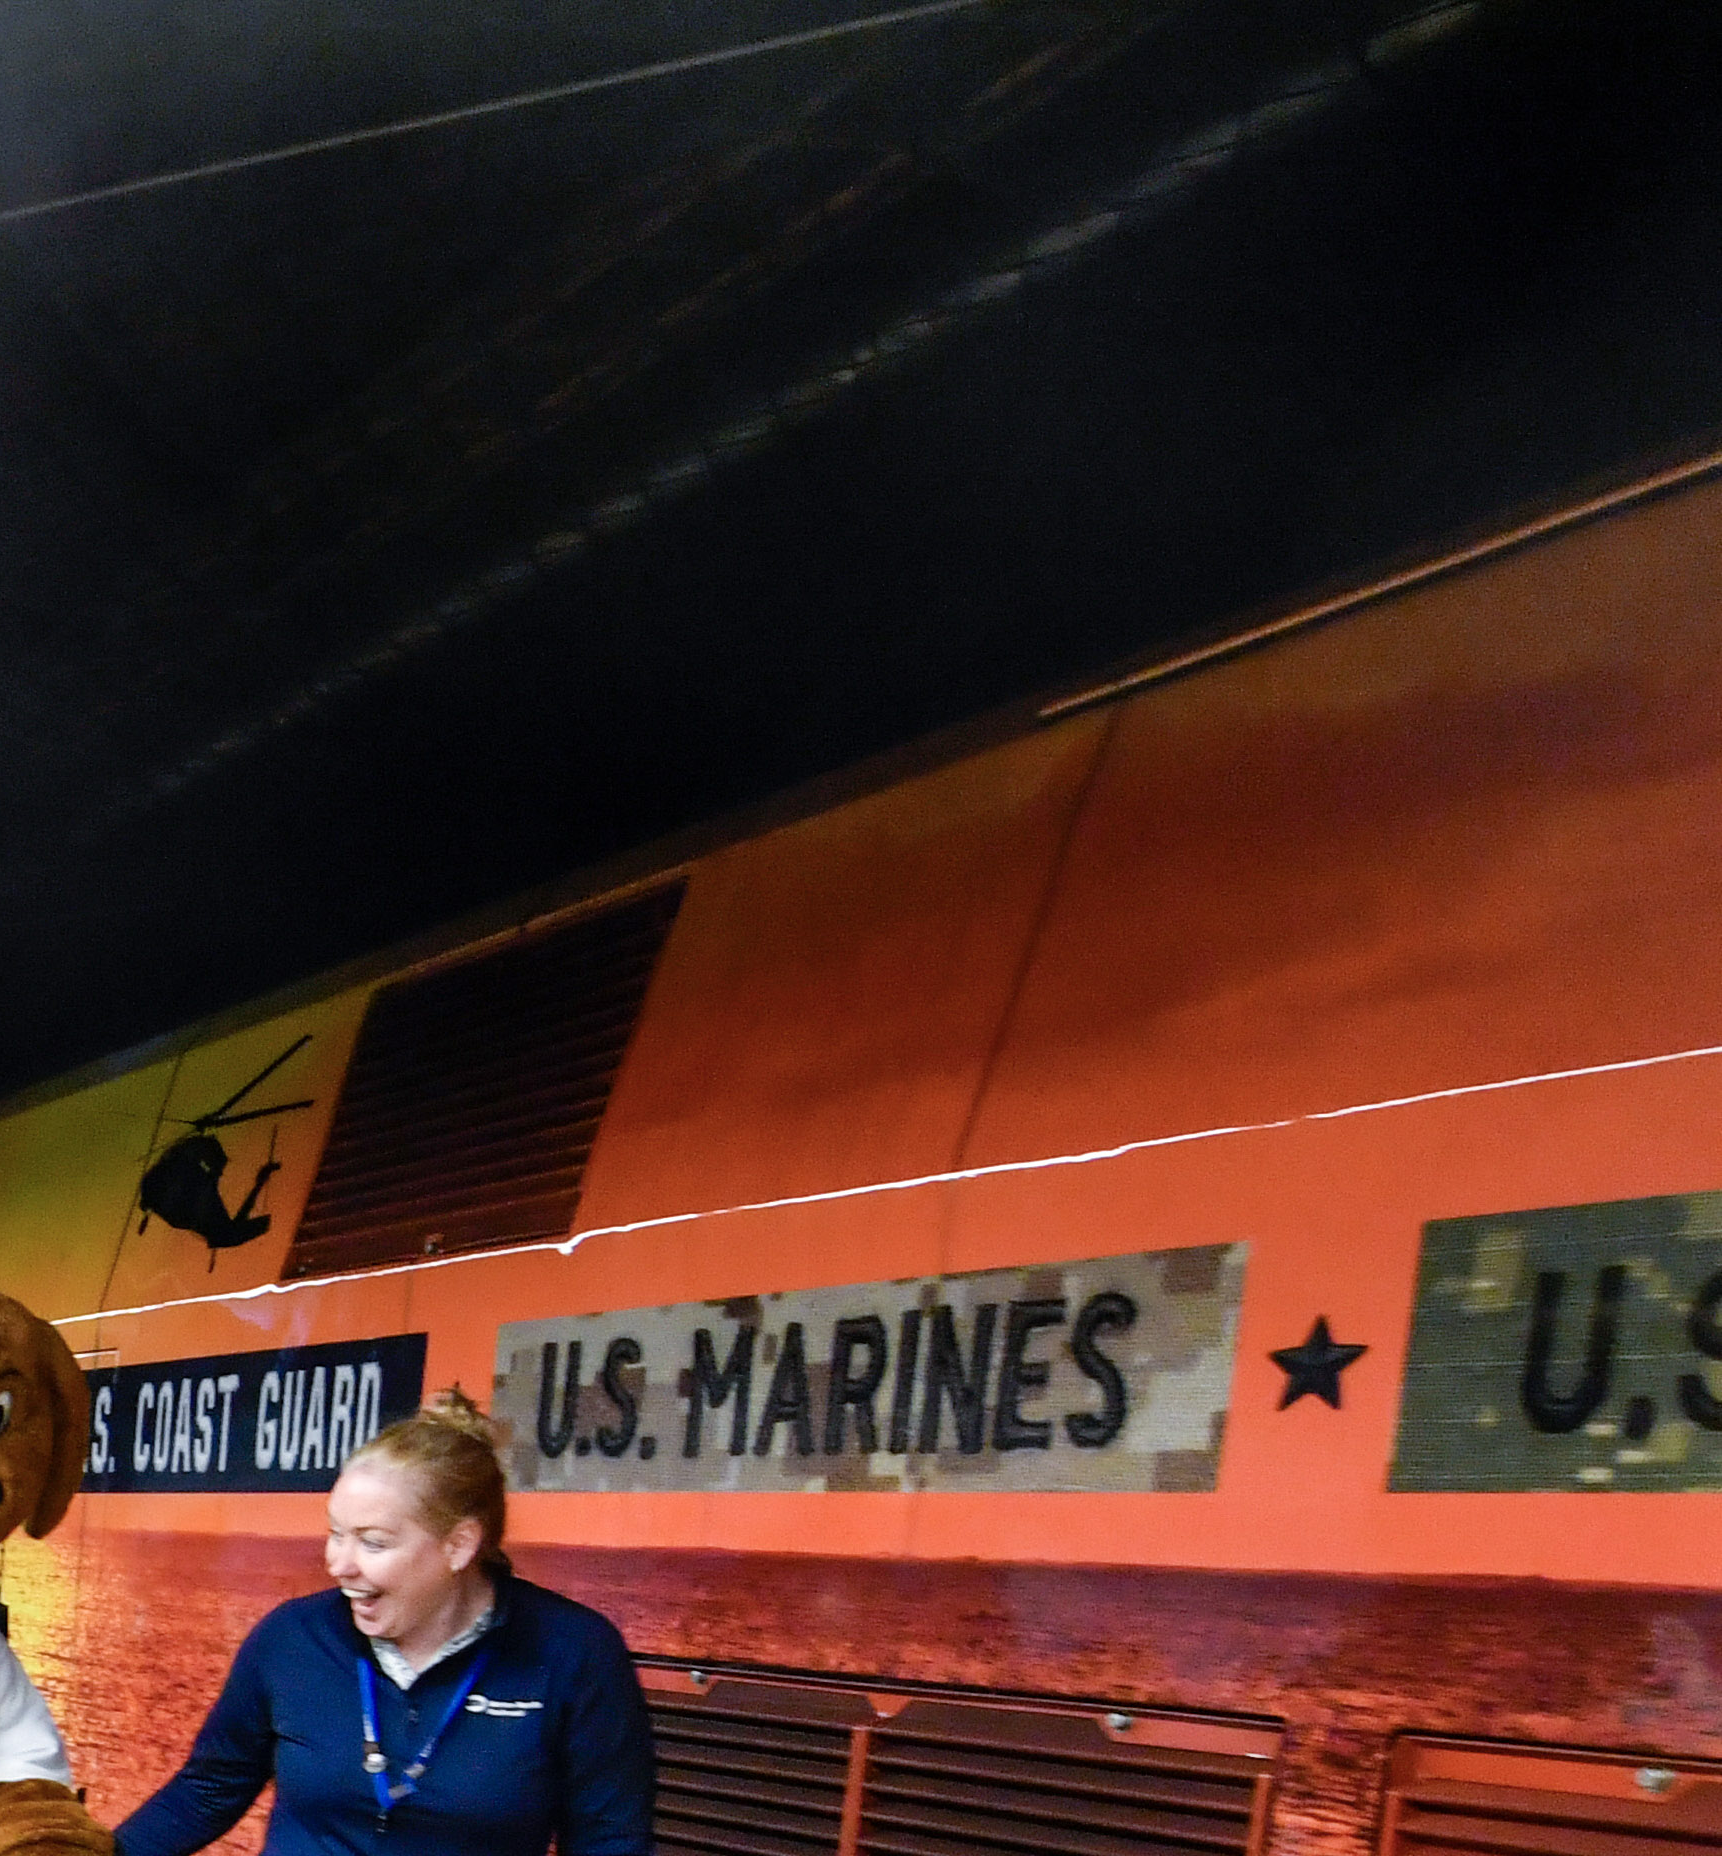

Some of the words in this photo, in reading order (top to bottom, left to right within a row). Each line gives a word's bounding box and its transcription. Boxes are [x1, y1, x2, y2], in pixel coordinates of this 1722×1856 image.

[132, 1373, 241, 1474] COAST
[255, 1360, 383, 1471] GUARD
[536, 1337, 656, 1460] U.S.
[681, 1290, 1137, 1459] MARINES
